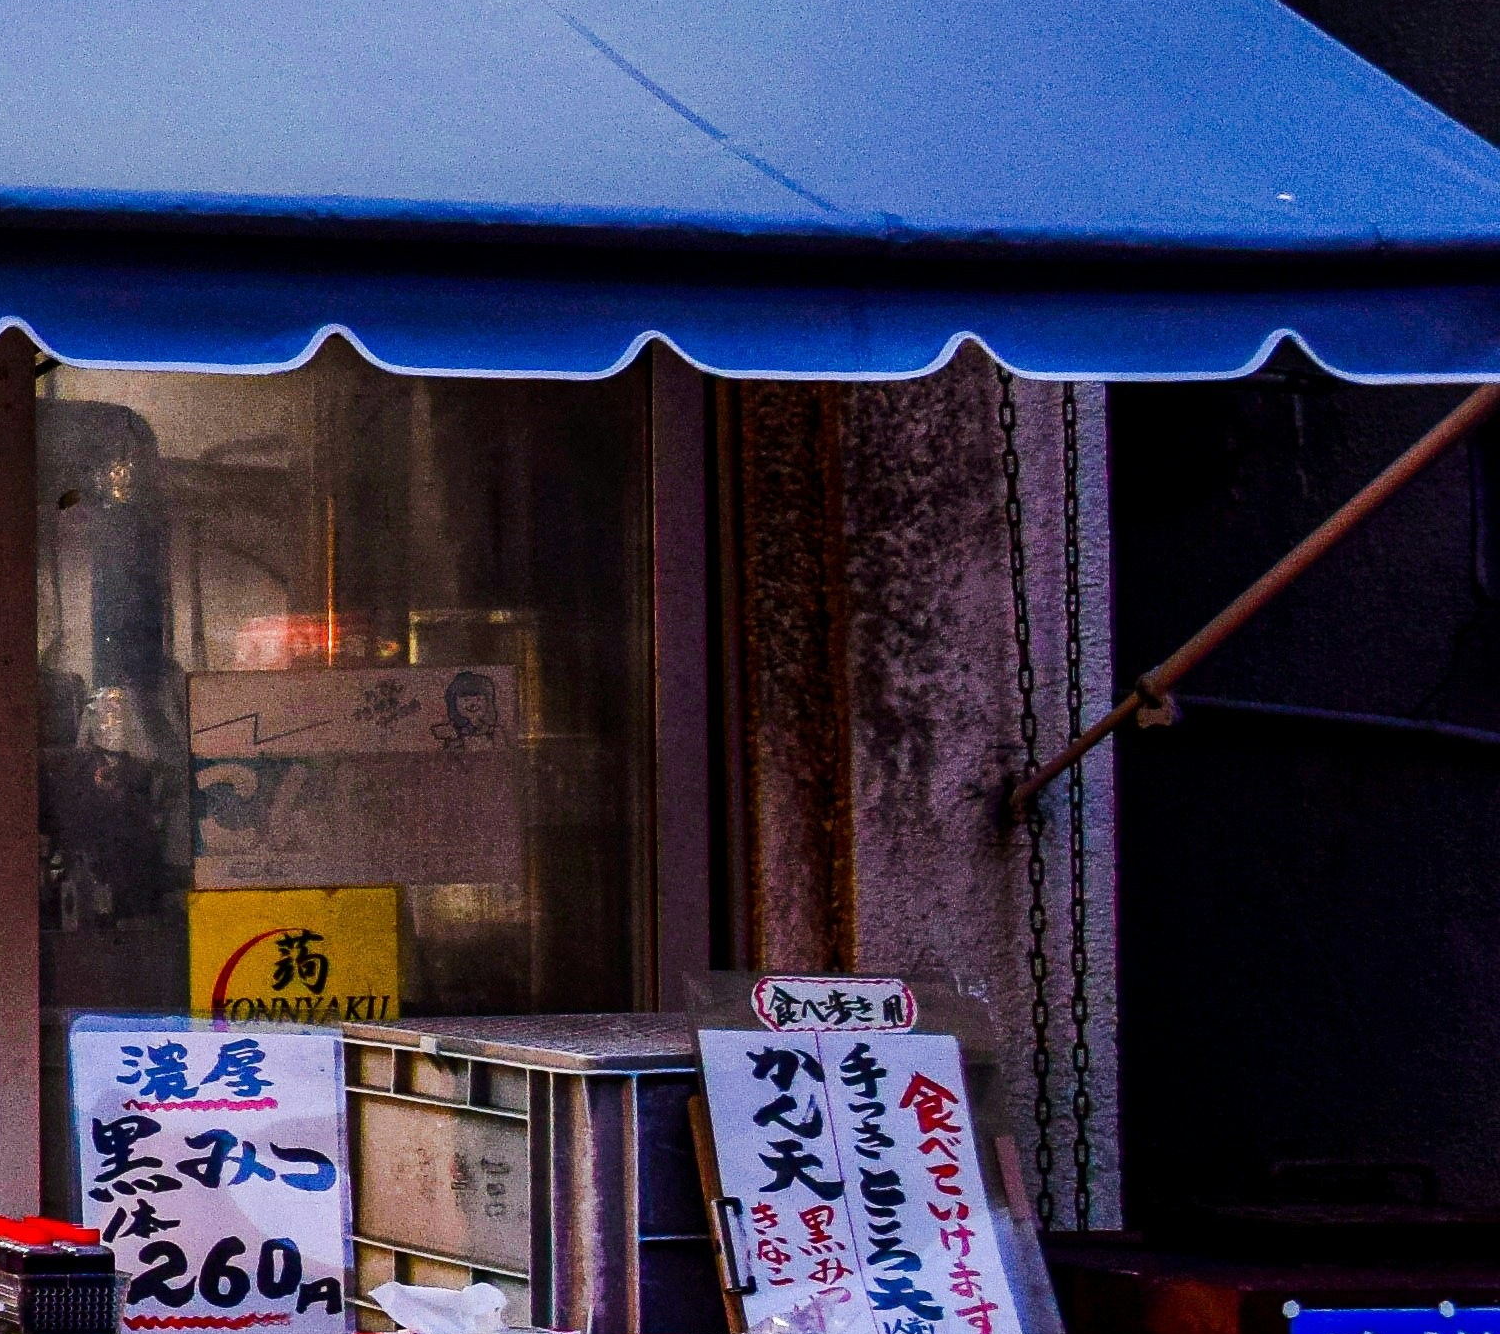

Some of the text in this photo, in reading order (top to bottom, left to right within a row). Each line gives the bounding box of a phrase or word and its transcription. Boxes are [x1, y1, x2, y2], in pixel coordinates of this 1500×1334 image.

[271, 929, 330, 994] 蒟
[769, 987, 906, 1025] 食べ歩き用
[116, 1038, 274, 1102] 濃厚
[88, 1115, 337, 1203] 黒みつ
[746, 1046, 845, 1202] かん天
[126, 1236, 342, 1315] 260円
